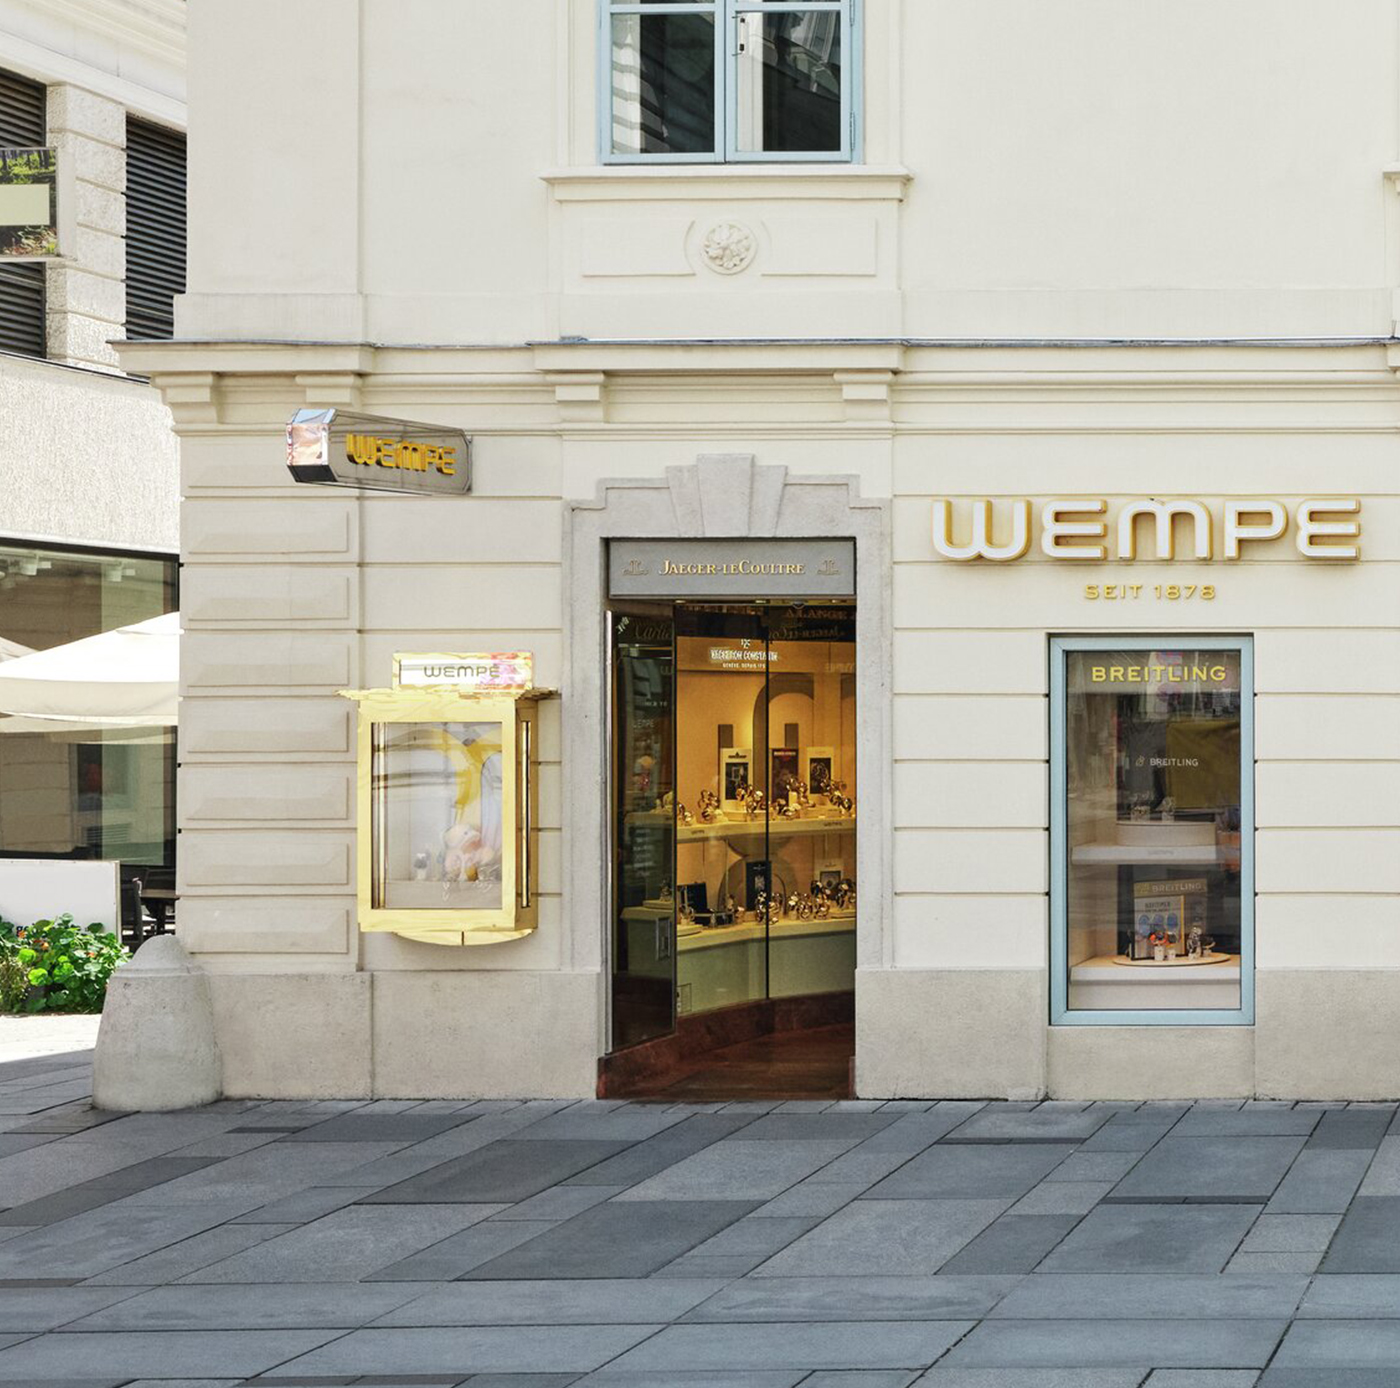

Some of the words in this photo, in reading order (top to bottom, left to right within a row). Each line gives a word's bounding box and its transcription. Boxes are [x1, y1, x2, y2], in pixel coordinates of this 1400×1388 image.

[346, 434, 456, 475] WEMPE
[931, 497, 1362, 562] WEMPE
[1084, 584, 1143, 600] SEIT
[1153, 584, 1216, 600] 1878
[423, 664, 501, 678] WEMPE
[1091, 666, 1227, 683] BREITLING
[1149, 757, 1199, 768] BREITLING
[1152, 882, 1201, 893] BREITLING
